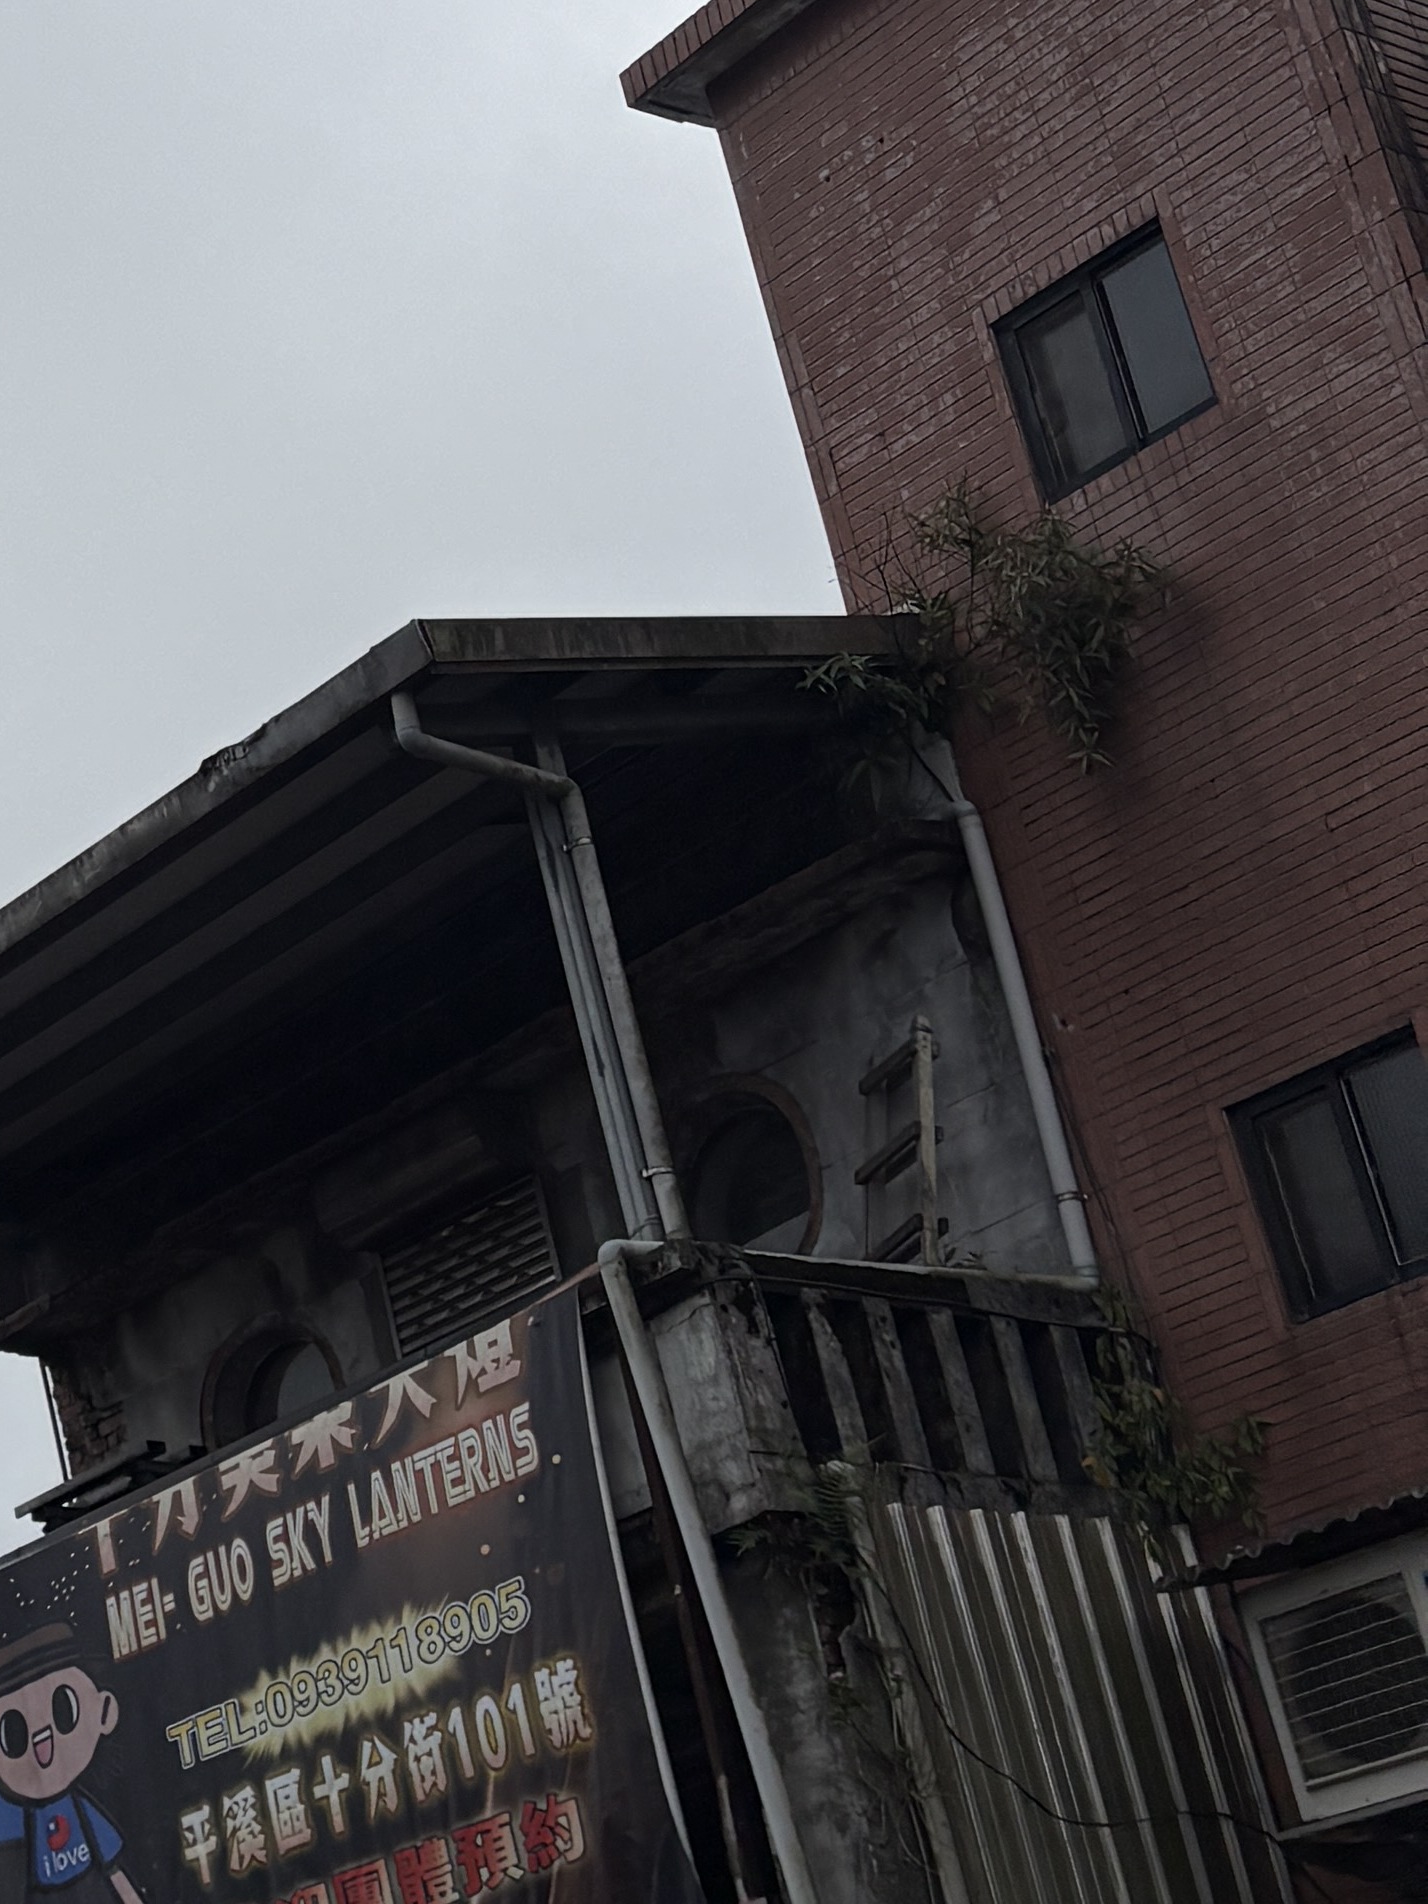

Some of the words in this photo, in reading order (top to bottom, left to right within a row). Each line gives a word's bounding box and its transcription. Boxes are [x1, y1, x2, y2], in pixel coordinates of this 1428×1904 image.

[187, 1536, 254, 1623] GUO
[265, 1494, 332, 1589] SKY
[347, 1400, 540, 1550] LANTERNS
[165, 1575, 532, 1770] TEL:0939118905
[180, 1656, 593, 1885] 平溪區十分街101號
[52, 1843, 91, 1874] love
